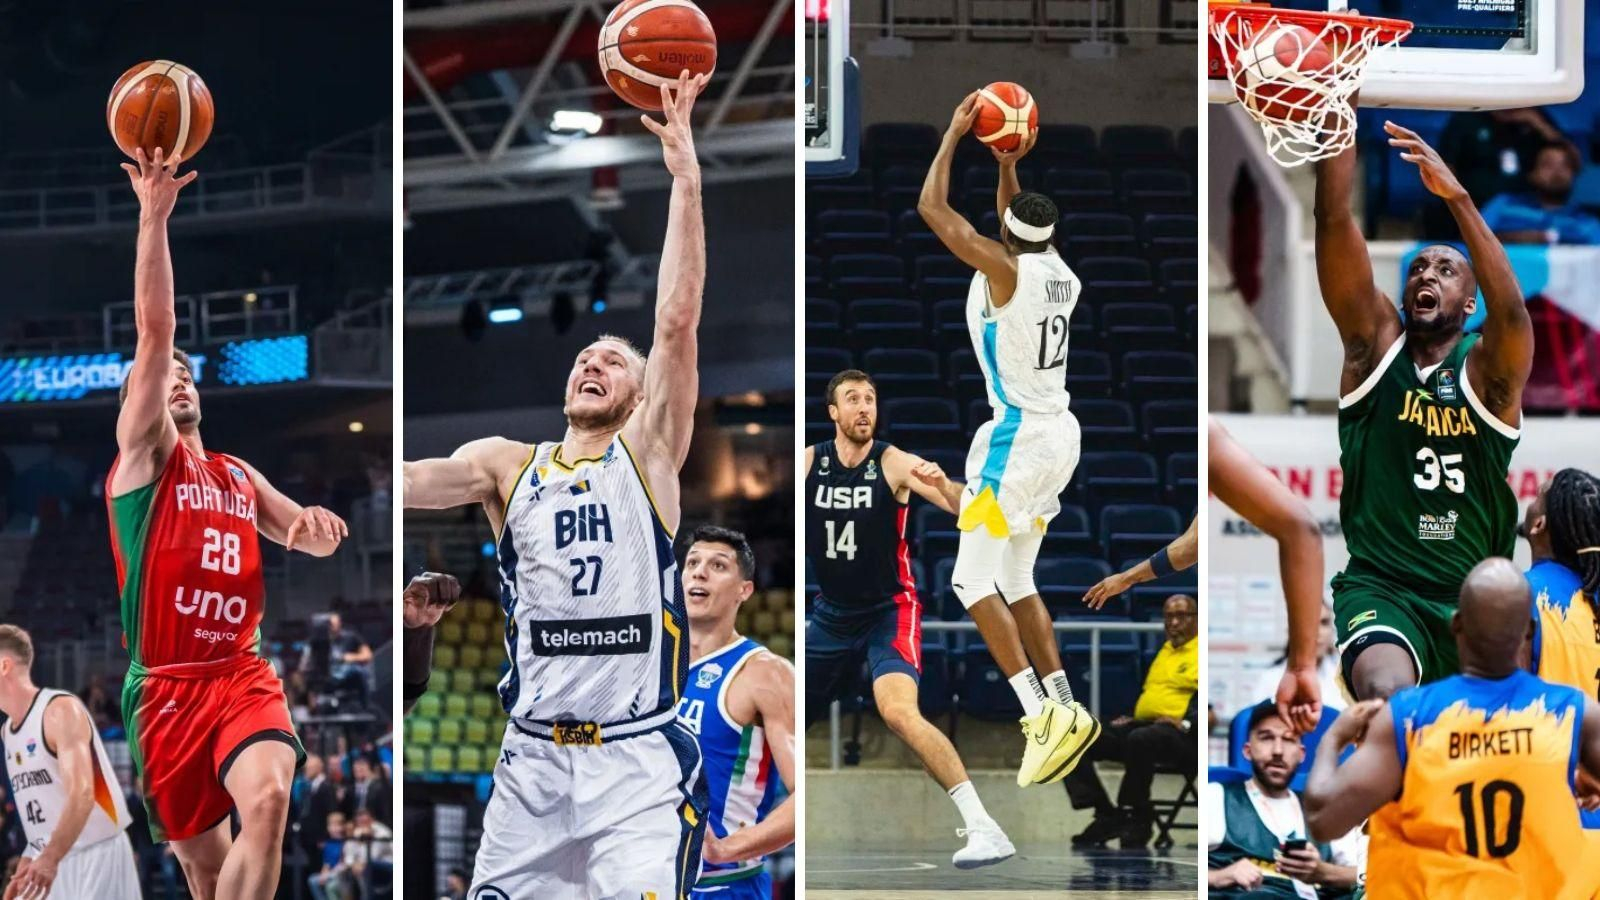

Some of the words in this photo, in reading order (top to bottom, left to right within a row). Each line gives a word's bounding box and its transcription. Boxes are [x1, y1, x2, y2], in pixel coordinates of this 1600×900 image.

[1033, 314, 1068, 370] 12
[1398, 389, 1477, 436] JAAICA
[1414, 446, 1466, 494] 35
[815, 484, 873, 509] USA
[555, 503, 613, 550] BIH
[825, 520, 857, 560] 14
[1418, 522, 1456, 531] MARLEY
[201, 527, 241, 576] 28
[570, 555, 604, 597] 27
[175, 586, 247, 625] una
[541, 623, 641, 648] telemach
[1449, 727, 1533, 760] BIRKETT
[26, 799, 46, 825] 42
[1453, 778, 1525, 859] 10
